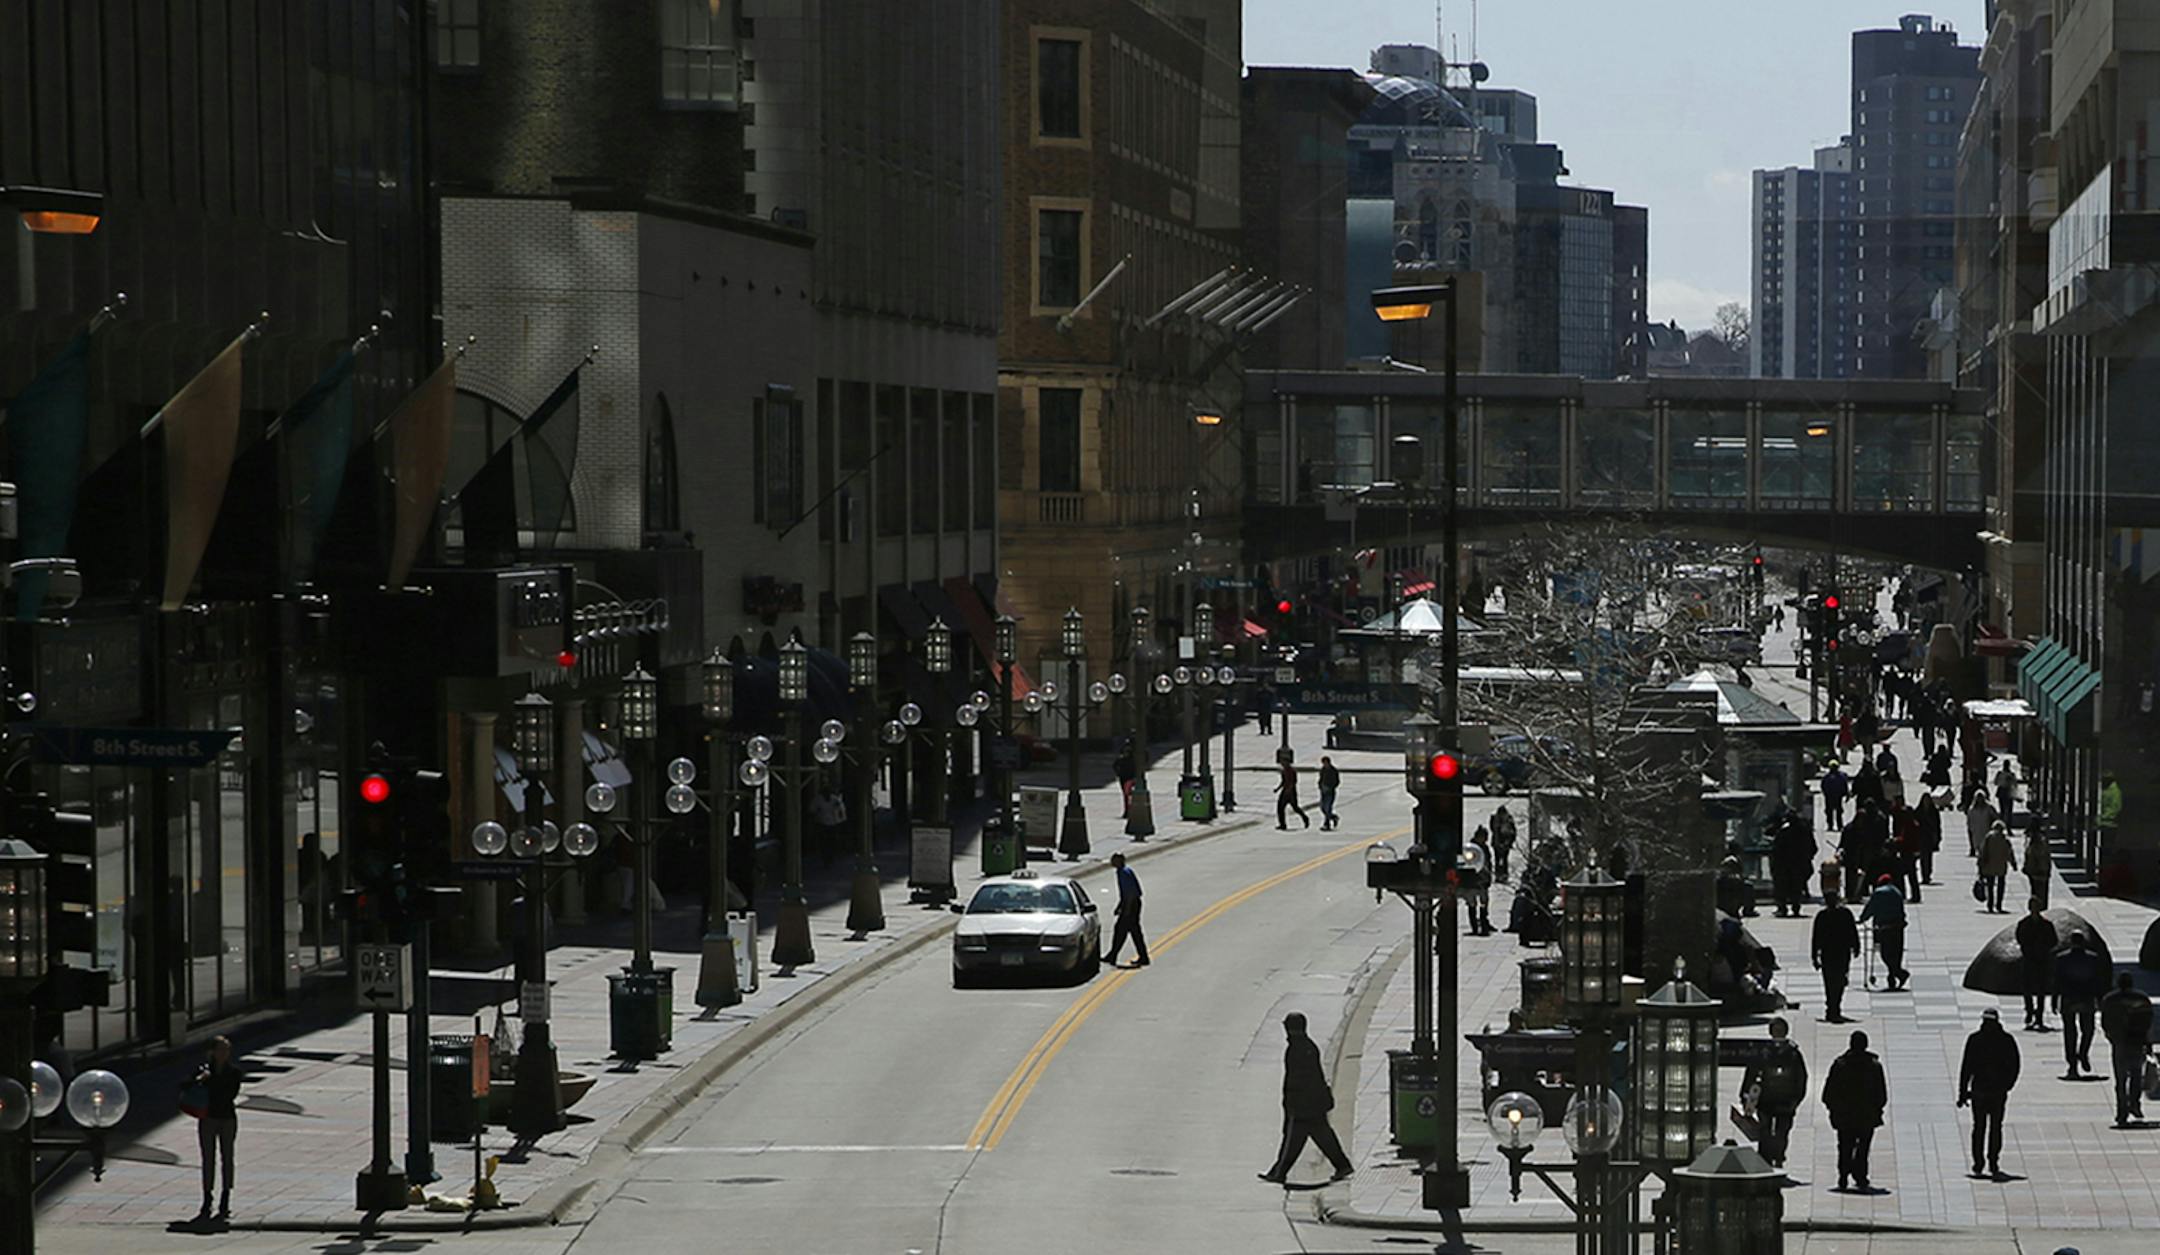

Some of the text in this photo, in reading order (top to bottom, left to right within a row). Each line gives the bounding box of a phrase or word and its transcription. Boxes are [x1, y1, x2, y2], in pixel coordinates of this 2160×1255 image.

[1579, 191, 1602, 216] 1221
[1301, 690, 1326, 703] 8th
[1328, 690, 1367, 704] Street
[94, 738, 204, 757] 8th Street S.
[361, 951, 395, 967] ONE
[360, 969, 396, 983] WAY
